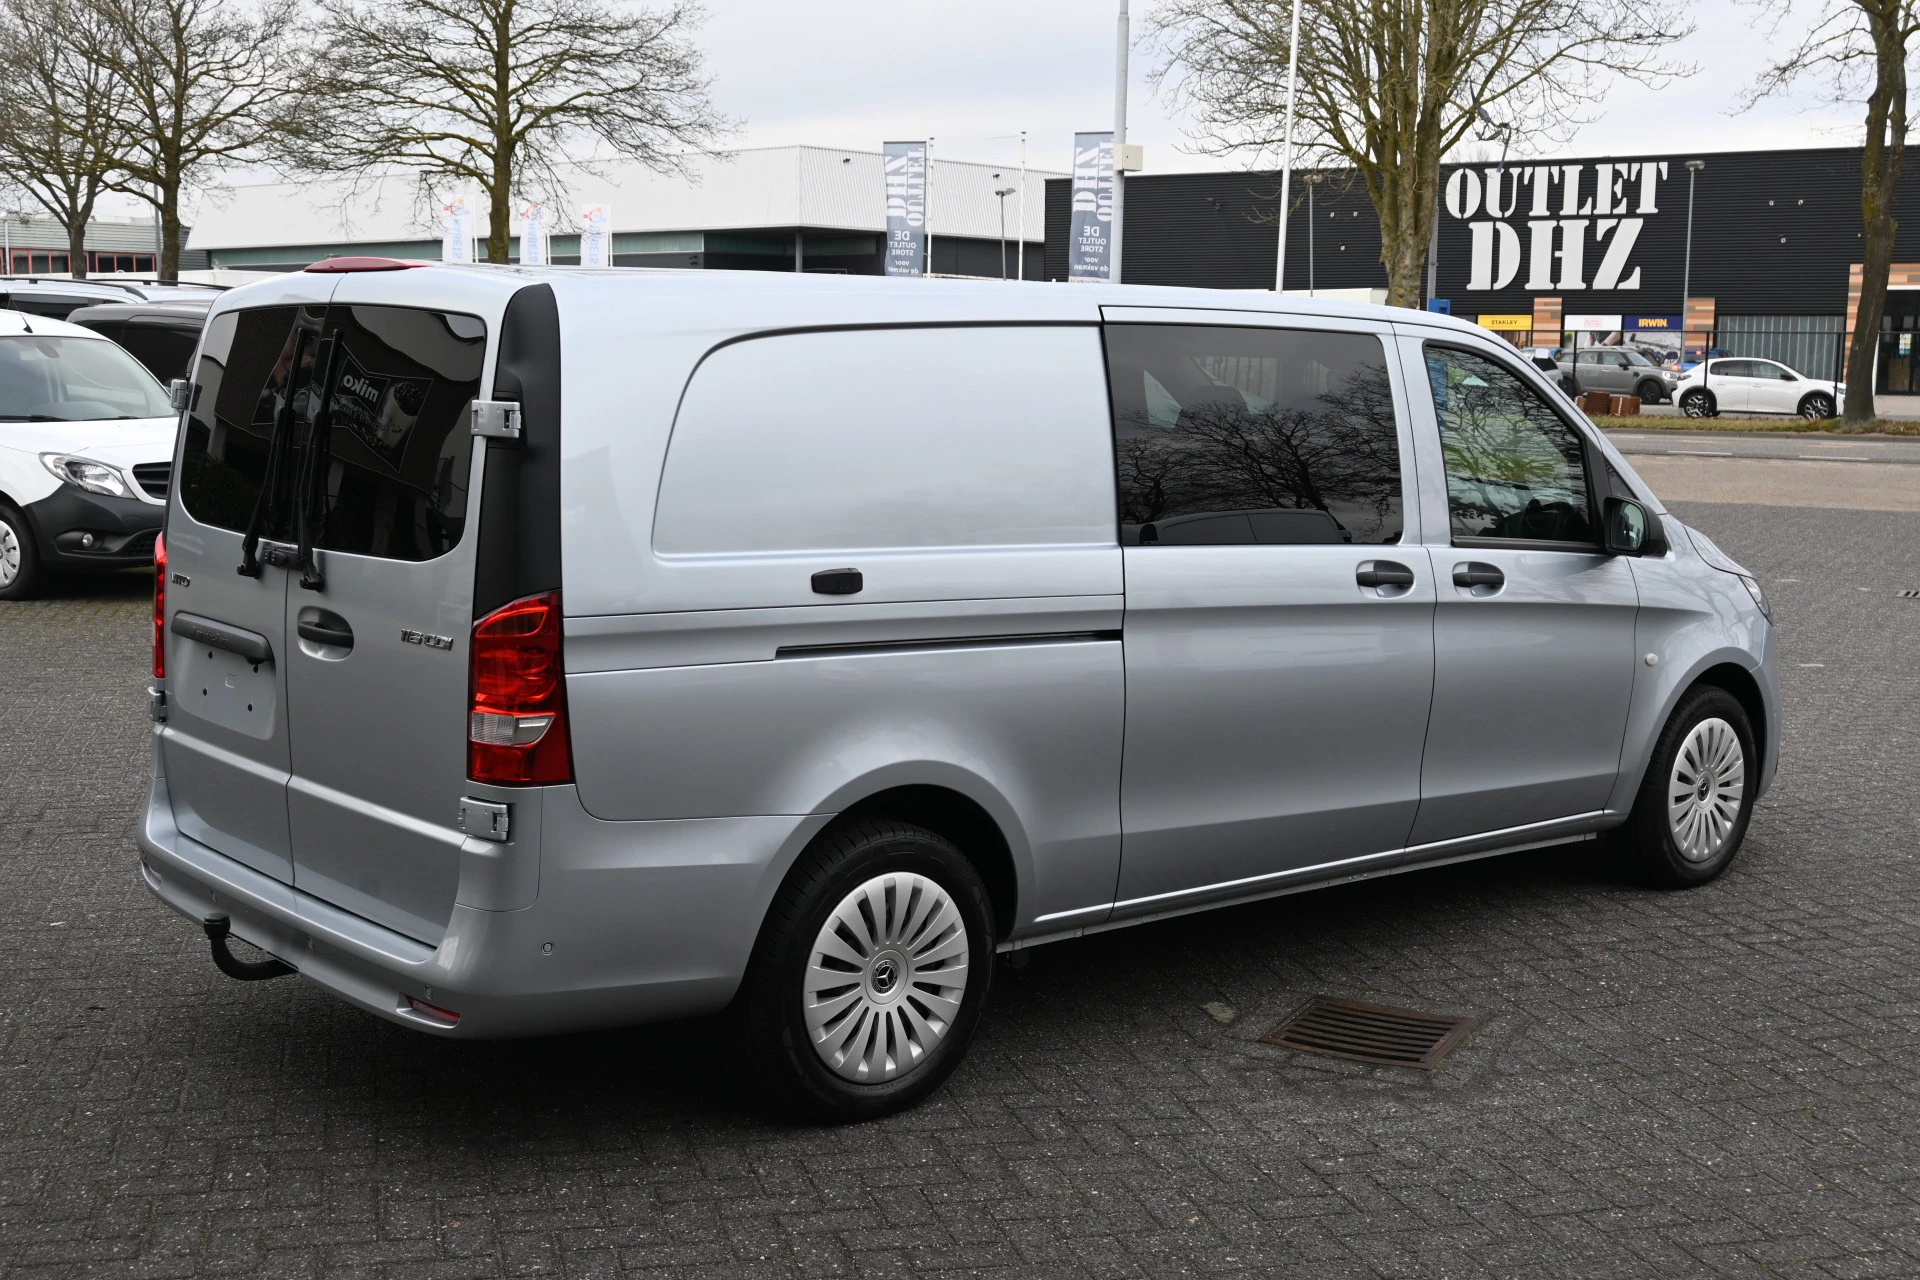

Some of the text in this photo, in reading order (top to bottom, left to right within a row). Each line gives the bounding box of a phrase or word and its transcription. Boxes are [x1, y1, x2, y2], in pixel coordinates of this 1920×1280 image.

[1445, 161, 1669, 220] OUTLET
[1466, 217, 1645, 291] DHZ
[1638, 318, 1667, 328] IRWIN
[424, 633, 454, 651] CDI
